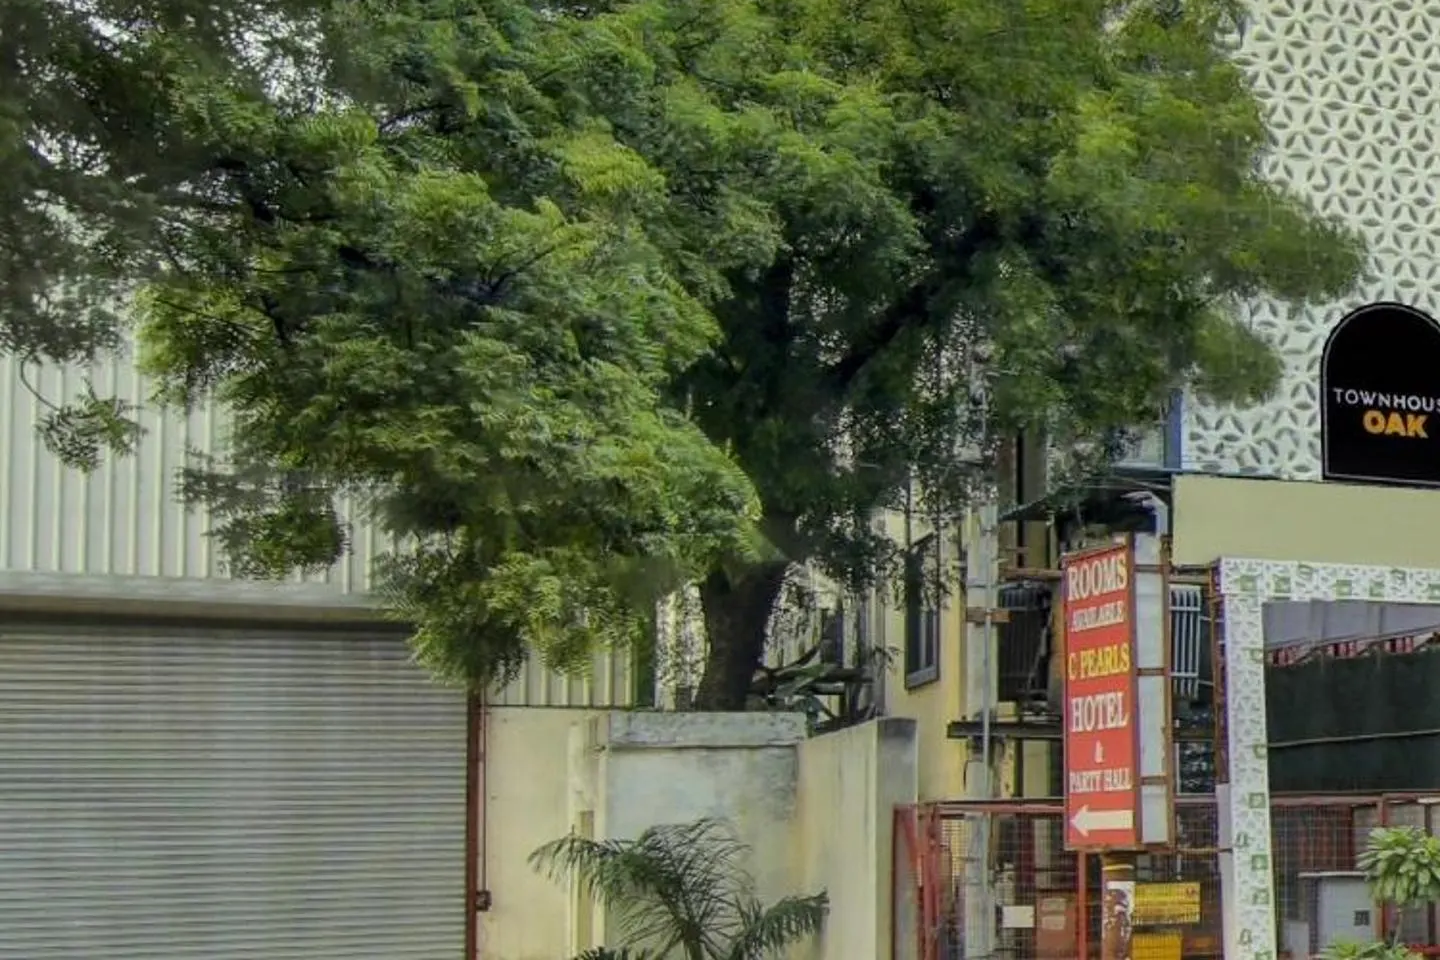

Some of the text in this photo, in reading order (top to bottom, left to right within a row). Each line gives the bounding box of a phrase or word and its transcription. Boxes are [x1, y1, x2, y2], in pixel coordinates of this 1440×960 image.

[1362, 409, 1430, 439] OAK
[1068, 553, 1127, 600] ROOMS
[1072, 601, 1124, 631] AVAILABLE
[1068, 642, 1130, 681] C PEARLS
[1072, 692, 1129, 732] HOTEL
[1069, 767, 1132, 793] PARTY HALL
